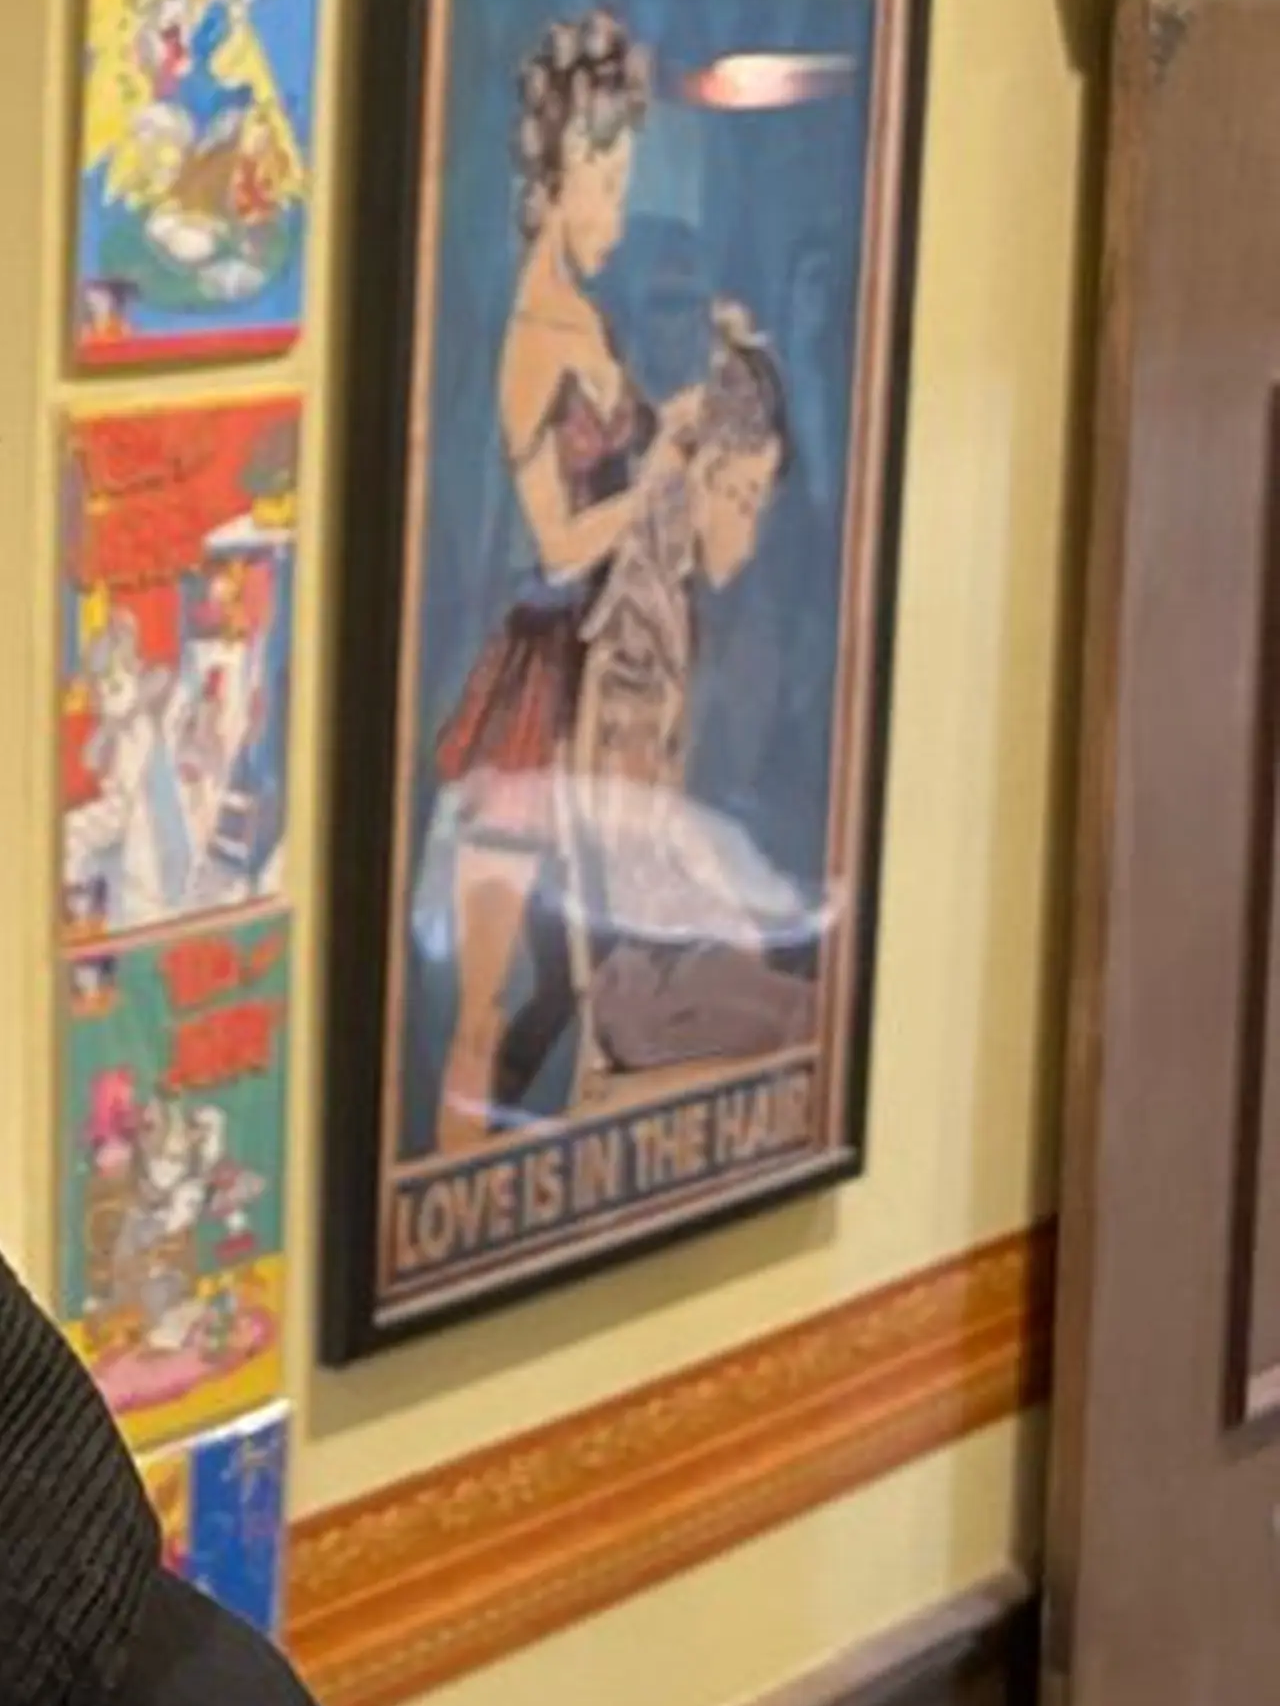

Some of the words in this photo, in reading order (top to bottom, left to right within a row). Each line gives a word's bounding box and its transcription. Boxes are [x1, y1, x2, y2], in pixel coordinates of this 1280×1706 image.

[396, 1163, 515, 1269] LOVE
[523, 1149, 563, 1229] IS
[572, 1128, 623, 1209] IN
[629, 1101, 706, 1189] THE
